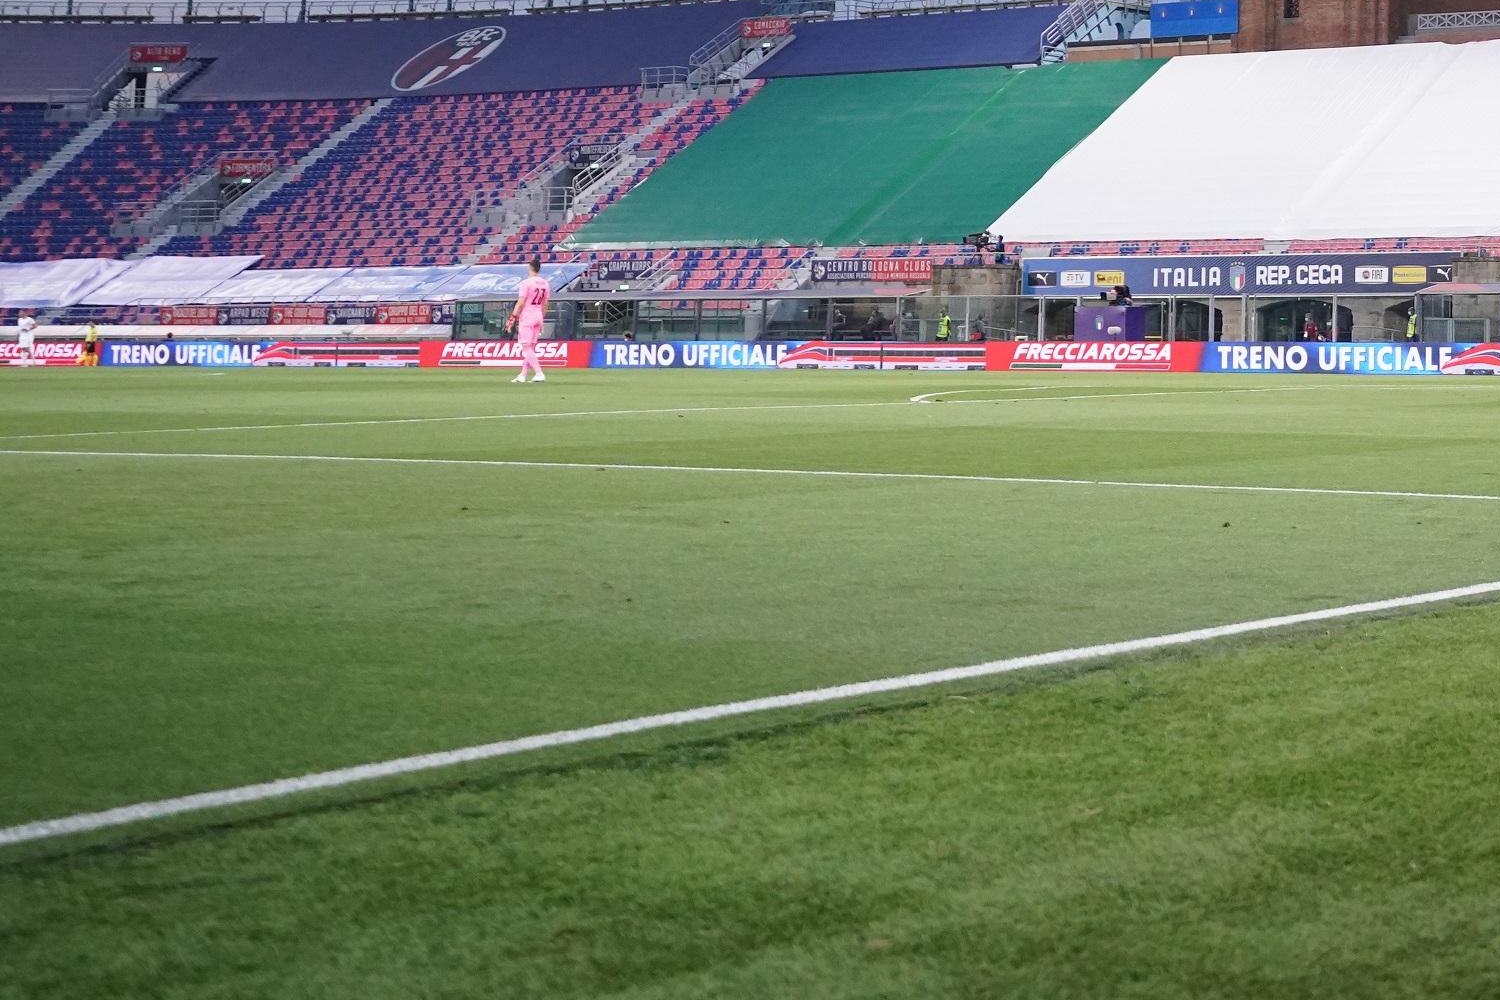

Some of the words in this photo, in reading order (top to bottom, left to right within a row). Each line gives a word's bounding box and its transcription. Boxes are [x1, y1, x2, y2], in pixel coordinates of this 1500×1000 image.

[827, 260, 859, 272] CENTRO
[862, 260, 899, 272] BOLOGNA
[904, 260, 931, 271] CLUBS
[1256, 265, 1292, 286] REP.
[1296, 264, 1343, 285] CECA
[1153, 267, 1221, 288] ITALIA
[111, 344, 170, 364] TRENO
[175, 344, 260, 364] UFFICIALE
[442, 343, 568, 358] FRECCIARSSA
[604, 344, 675, 366] TRENO
[682, 344, 788, 366] UFFICIALE
[1013, 343, 1171, 361] FRECCIAROSSA
[1217, 345, 1308, 370] TRENO
[1318, 346, 1452, 372] UFFICIALE
